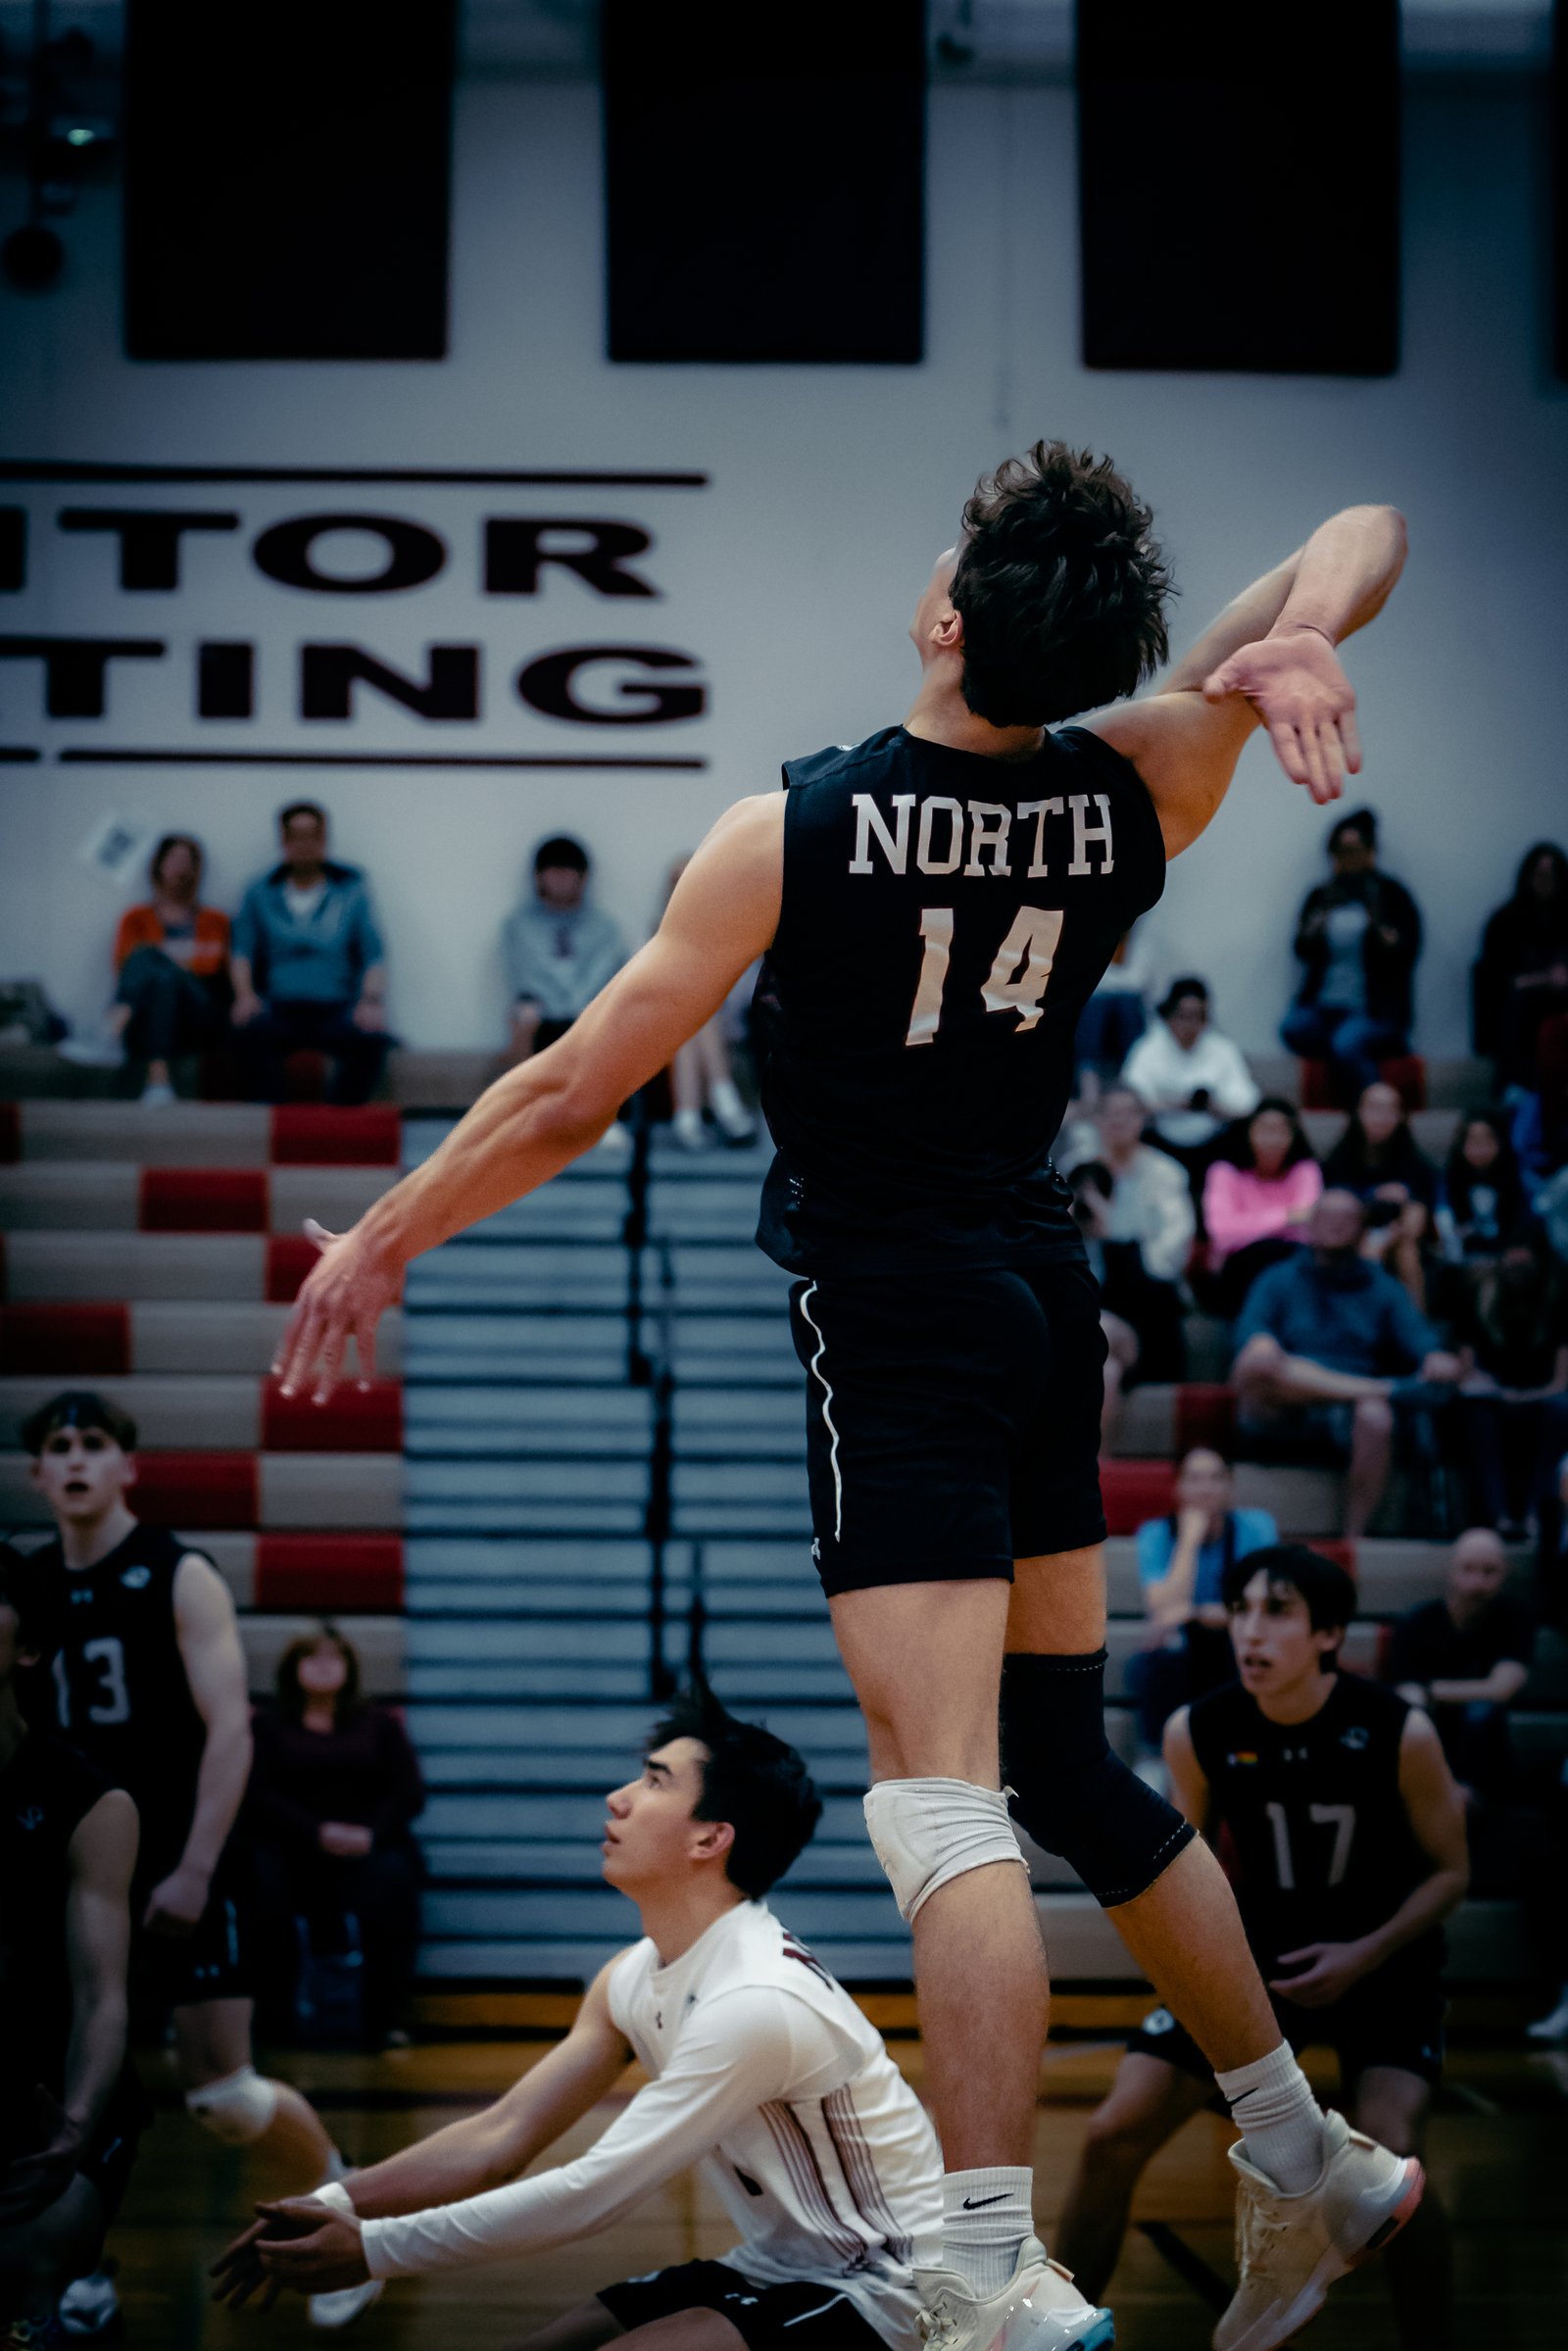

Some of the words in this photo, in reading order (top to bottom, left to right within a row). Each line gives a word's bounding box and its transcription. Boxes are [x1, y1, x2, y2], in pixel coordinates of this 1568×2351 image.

[0, 638, 706, 724] TING
[848, 792, 1116, 878] NORTH
[903, 905, 1066, 1049] 14
[51, 1638, 132, 1731] 13
[1265, 1801, 1356, 1891] 17
